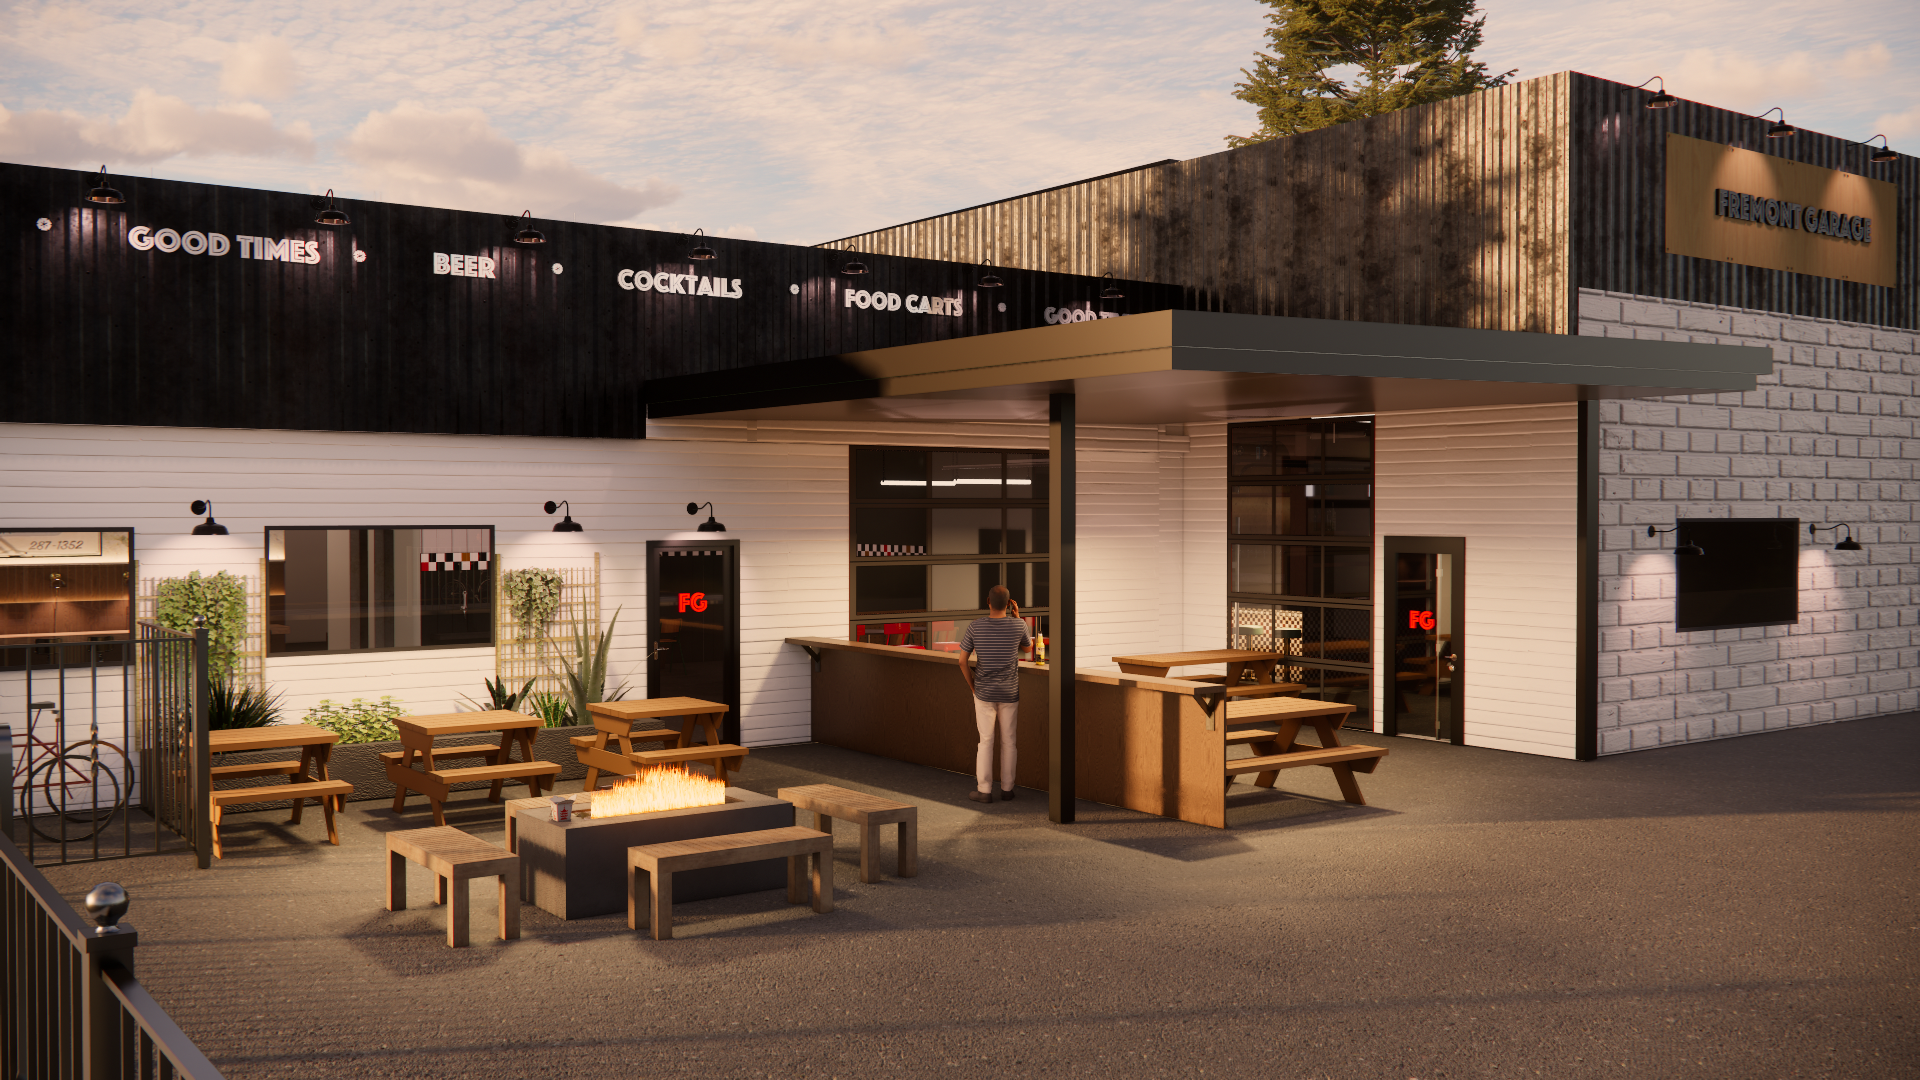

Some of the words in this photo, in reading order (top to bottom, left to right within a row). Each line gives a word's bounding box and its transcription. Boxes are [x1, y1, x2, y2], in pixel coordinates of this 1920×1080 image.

[1715, 188, 1801, 230] FREMONT
[1802, 206, 1872, 243] GARAGE
[128, 225, 231, 257] GOOD
[236, 234, 321, 265] TIMES
[433, 252, 496, 279] BEER
[617, 268, 743, 299] COCKTAILS
[844, 288, 902, 312] FOOD
[905, 294, 963, 317] CARTS
[1043, 306, 1098, 325] GOOD
[28, 540, 84, 551] 287-1352
[678, 591, 708, 613] FG
[1409, 610, 1436, 630] FG
